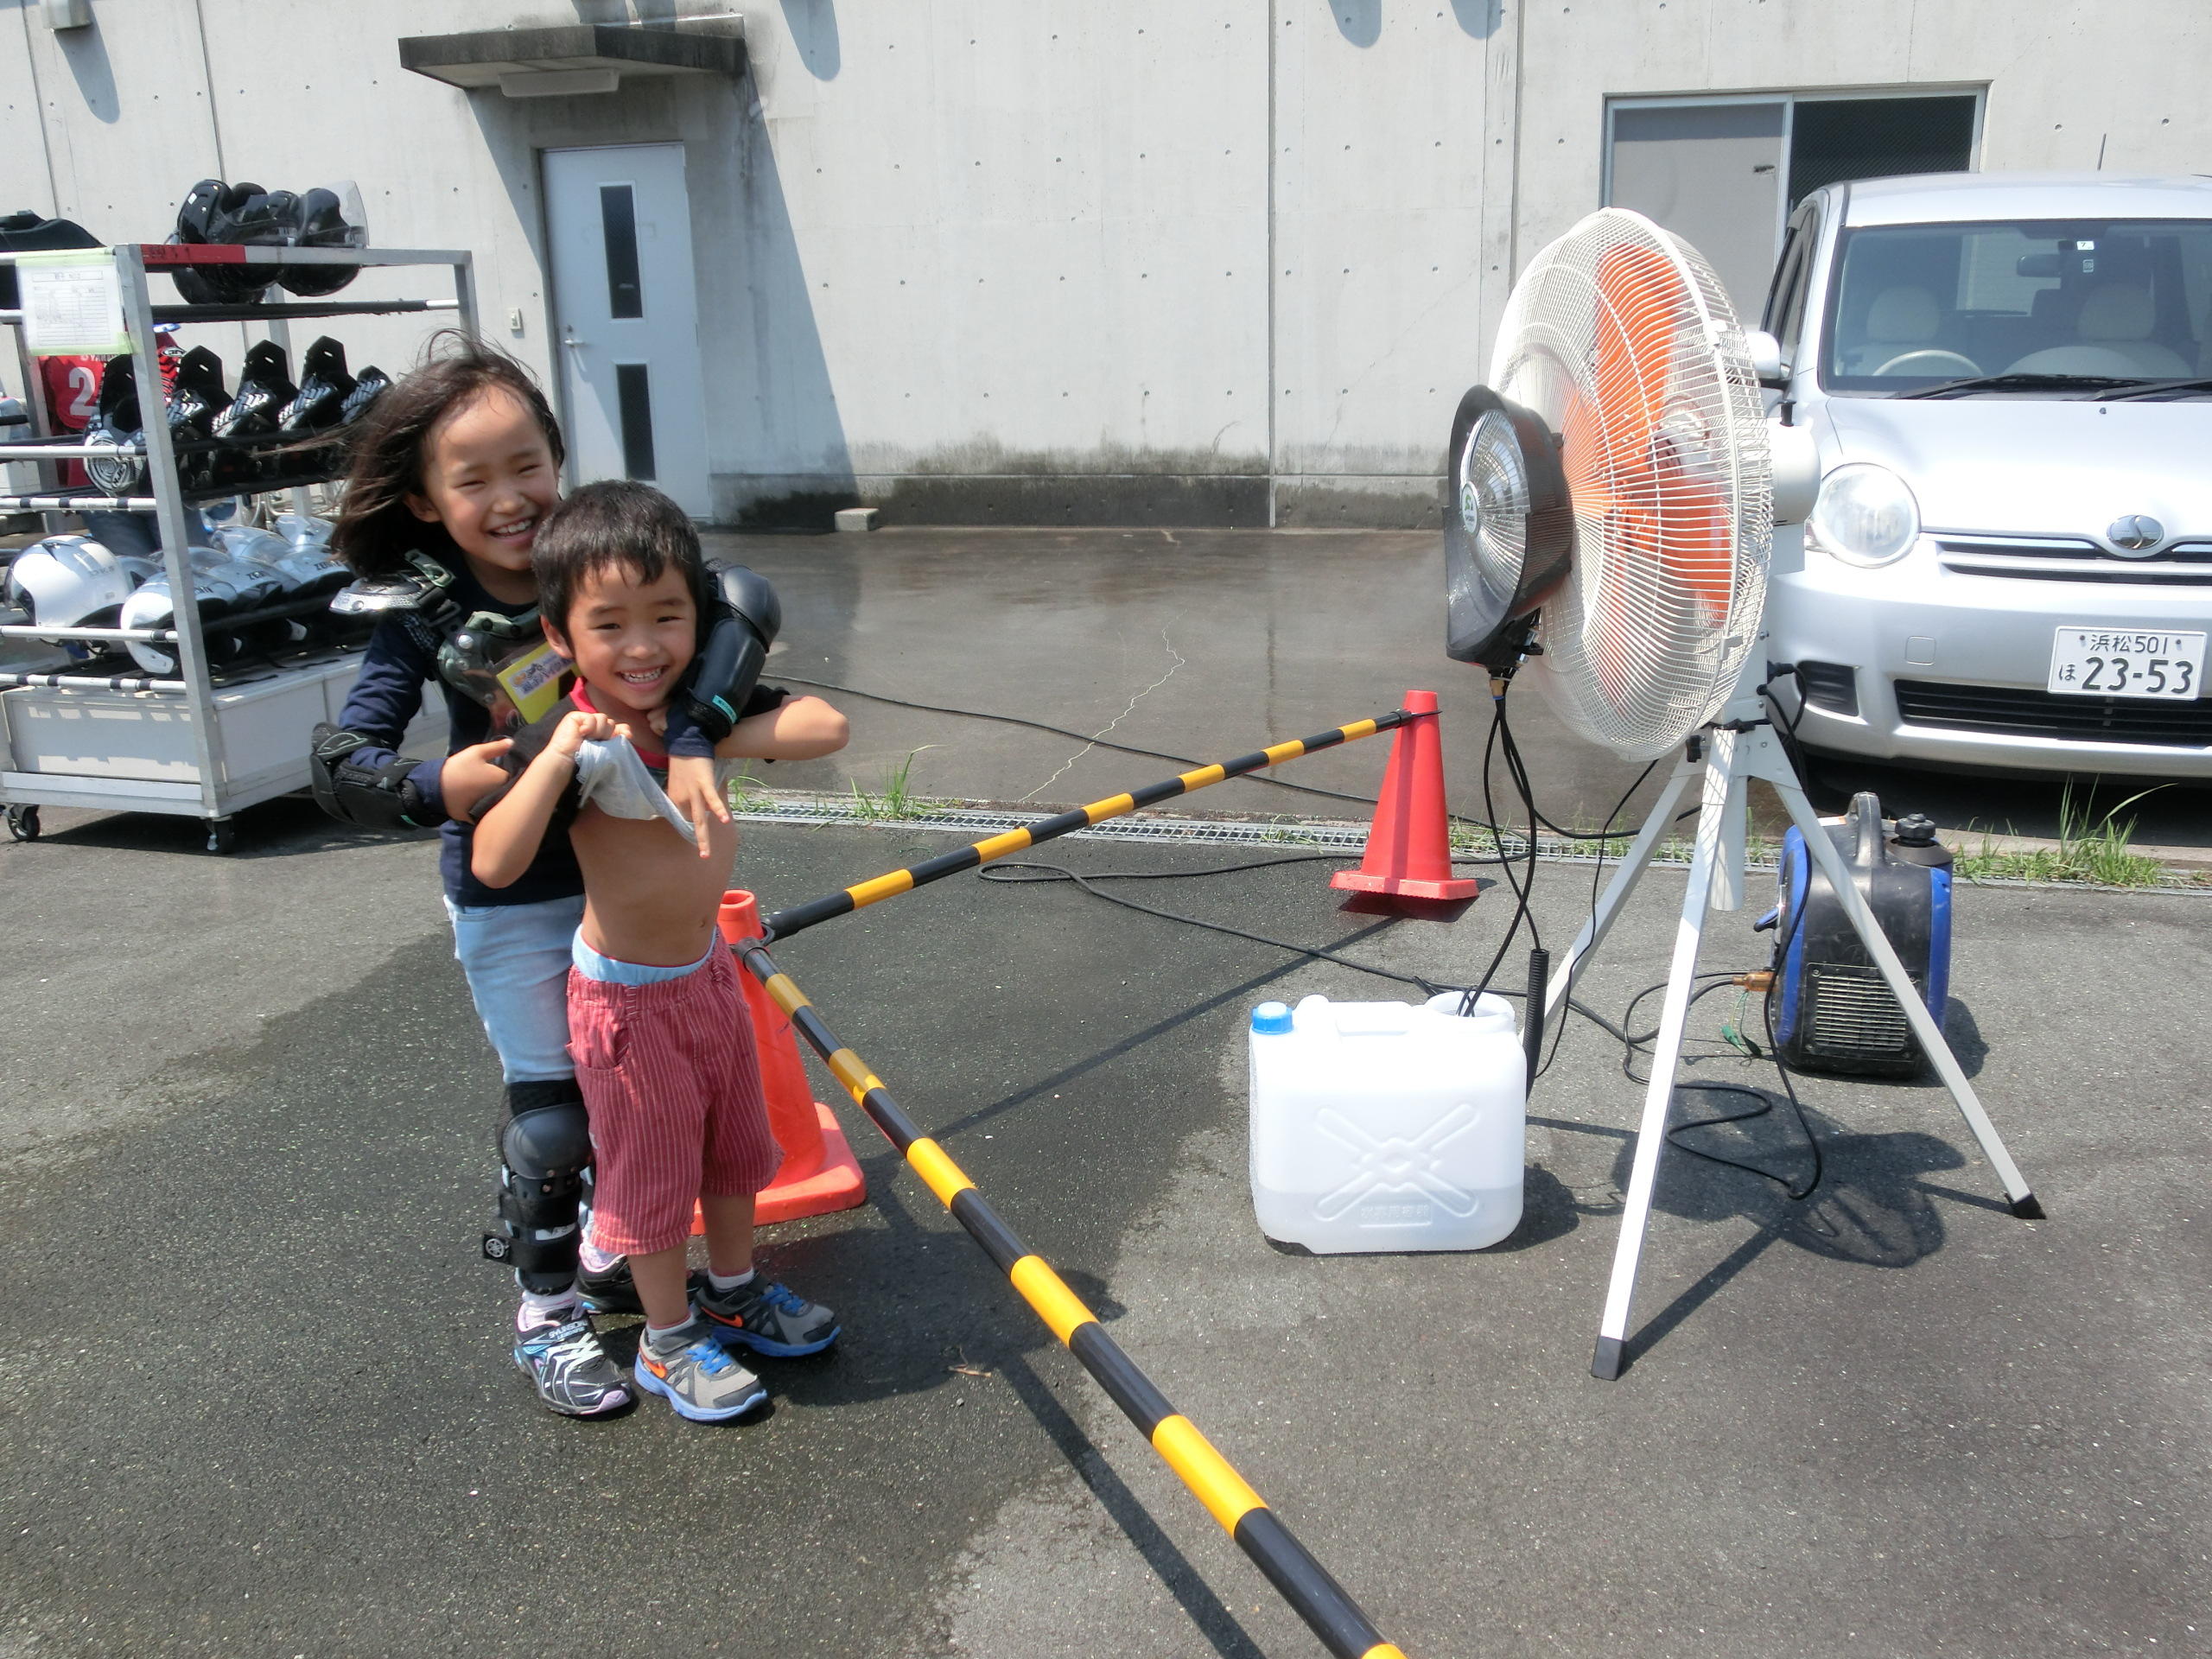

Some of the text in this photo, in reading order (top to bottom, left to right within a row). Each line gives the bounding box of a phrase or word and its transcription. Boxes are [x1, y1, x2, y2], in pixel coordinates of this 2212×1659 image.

[69, 367, 100, 416] 2
[2058, 657, 2194, 694] ほ 23-53
